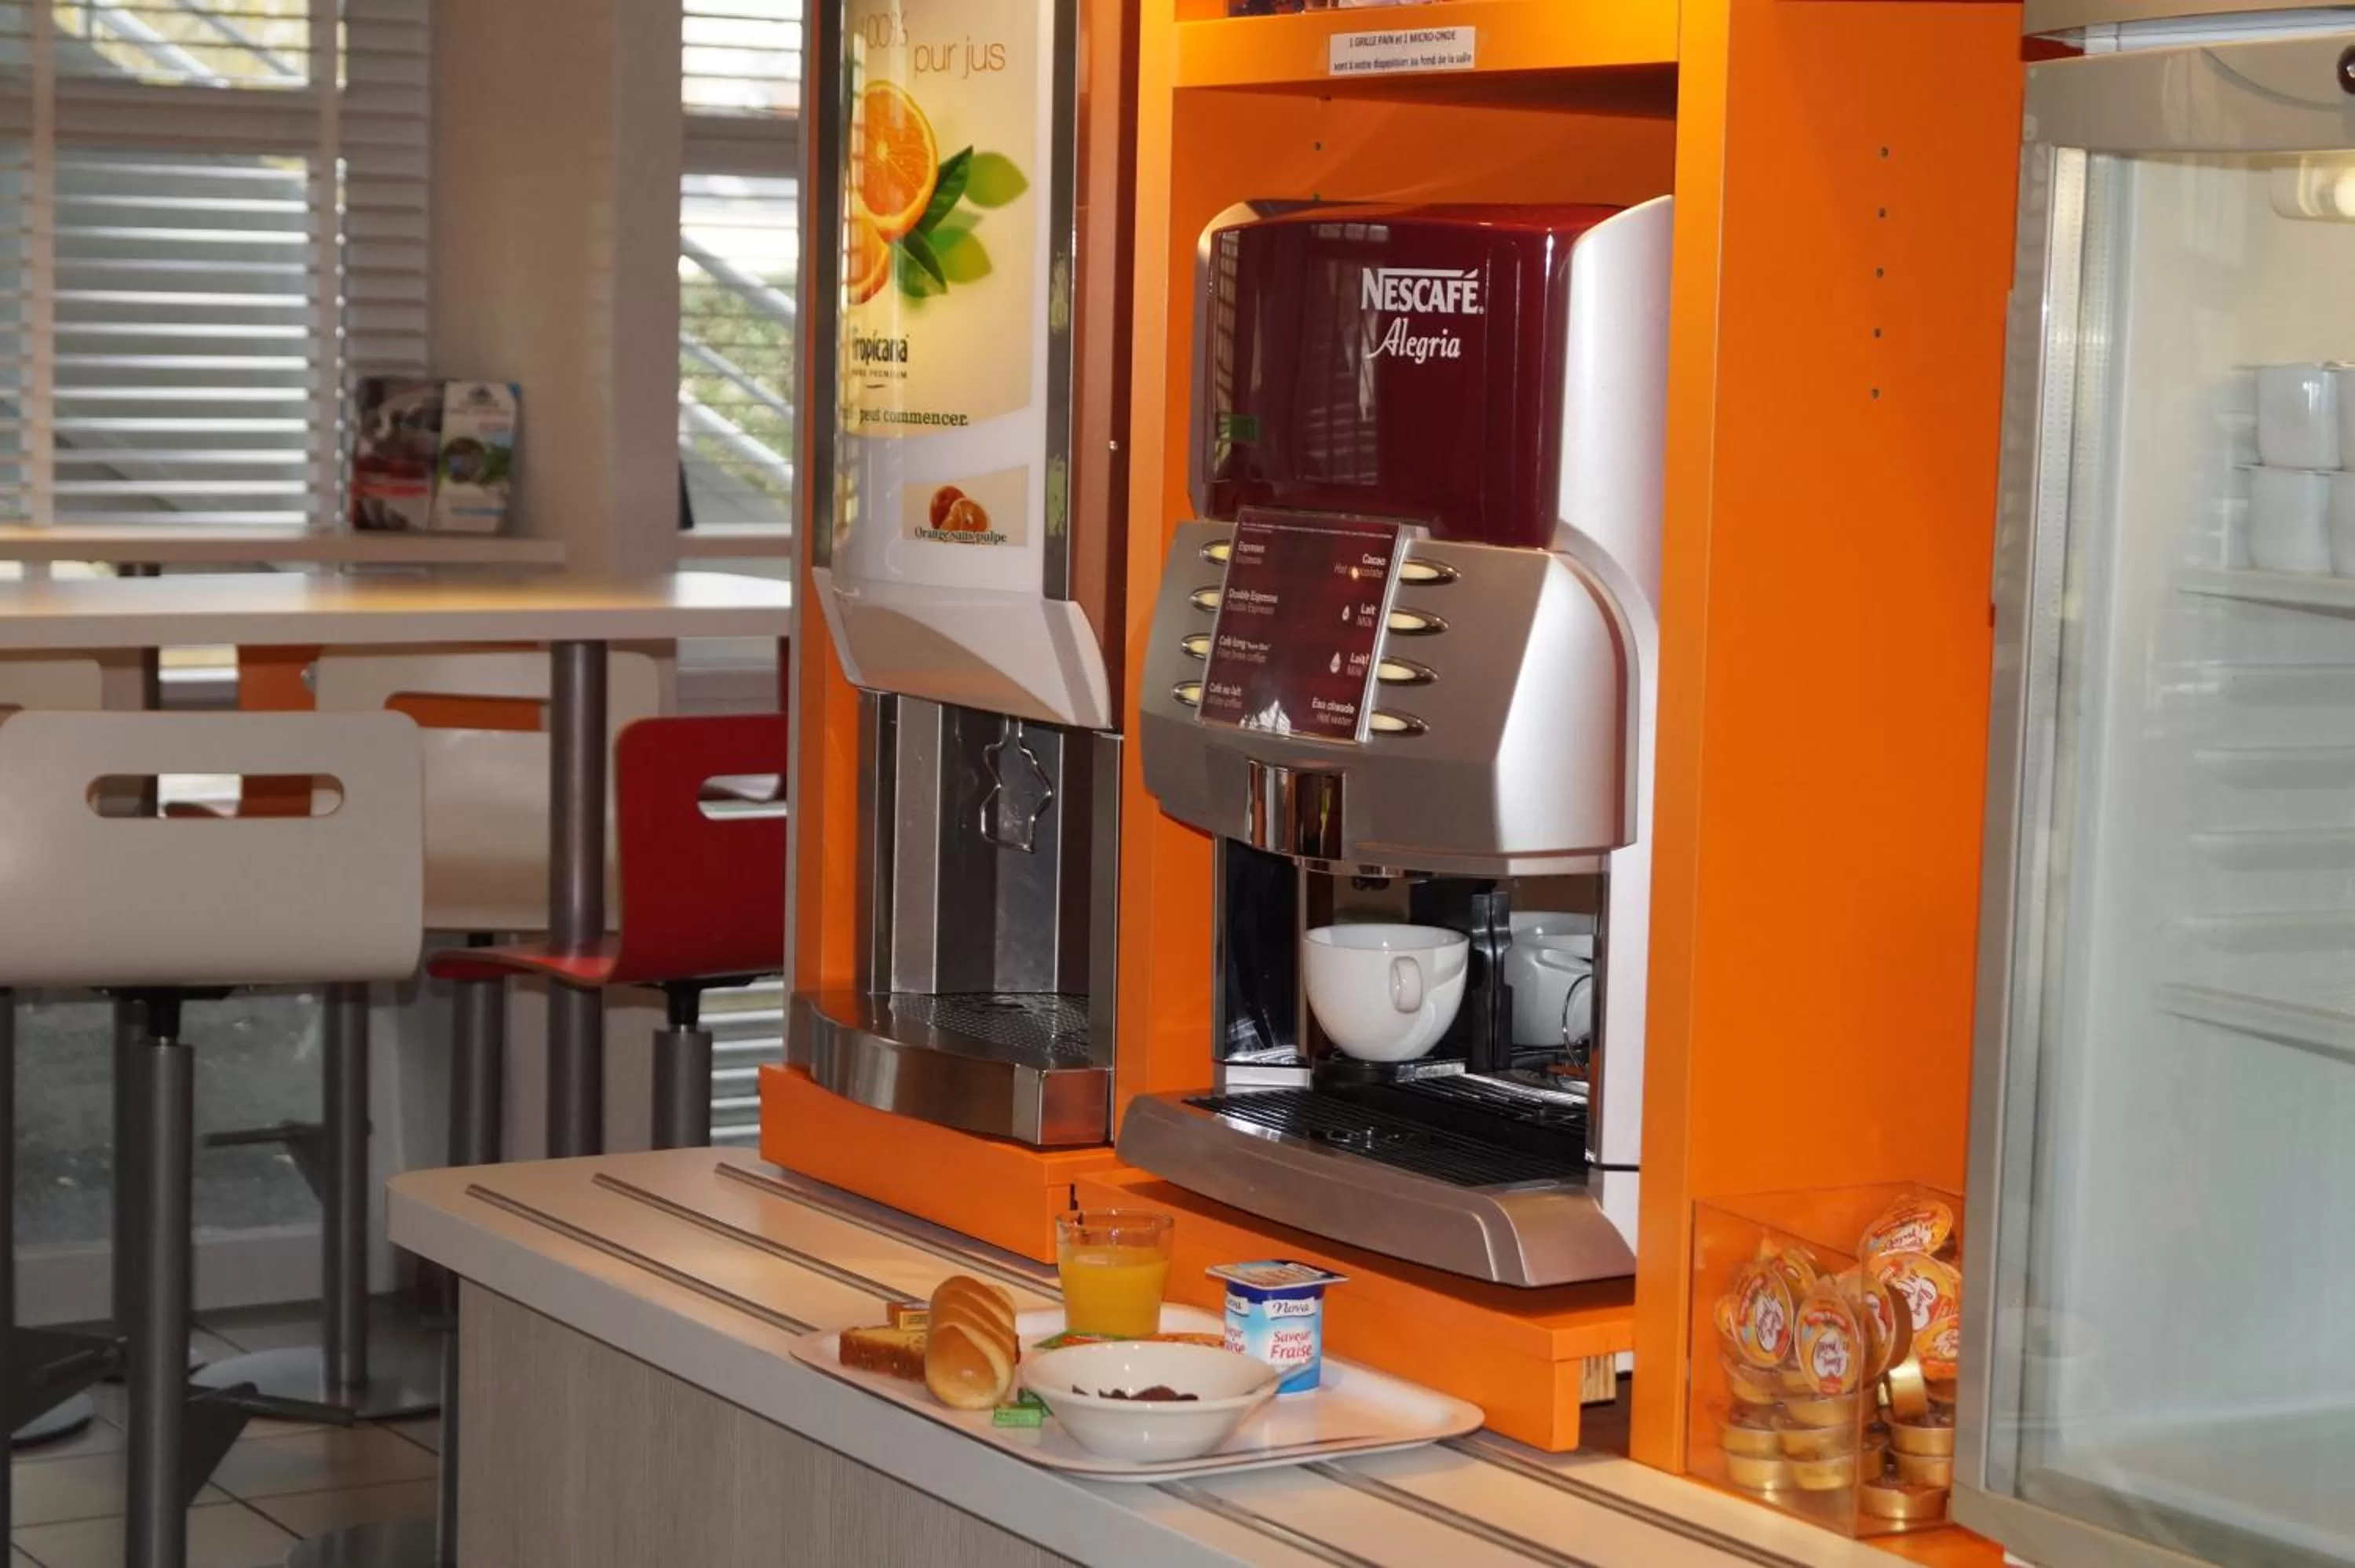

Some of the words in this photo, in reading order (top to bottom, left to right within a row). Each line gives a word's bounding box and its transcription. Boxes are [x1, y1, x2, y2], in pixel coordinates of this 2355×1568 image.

[860, 11, 909, 49] 00%
[914, 43, 958, 79] pur
[962, 35, 1006, 79] jus
[1360, 267, 1481, 314] NESCAFÉ
[1365, 317, 1462, 364] Alegria
[883, 410, 969, 427] commencer.
[1269, 1344, 1313, 1358] Fraise
[1273, 1330, 1312, 1343] Saveur
